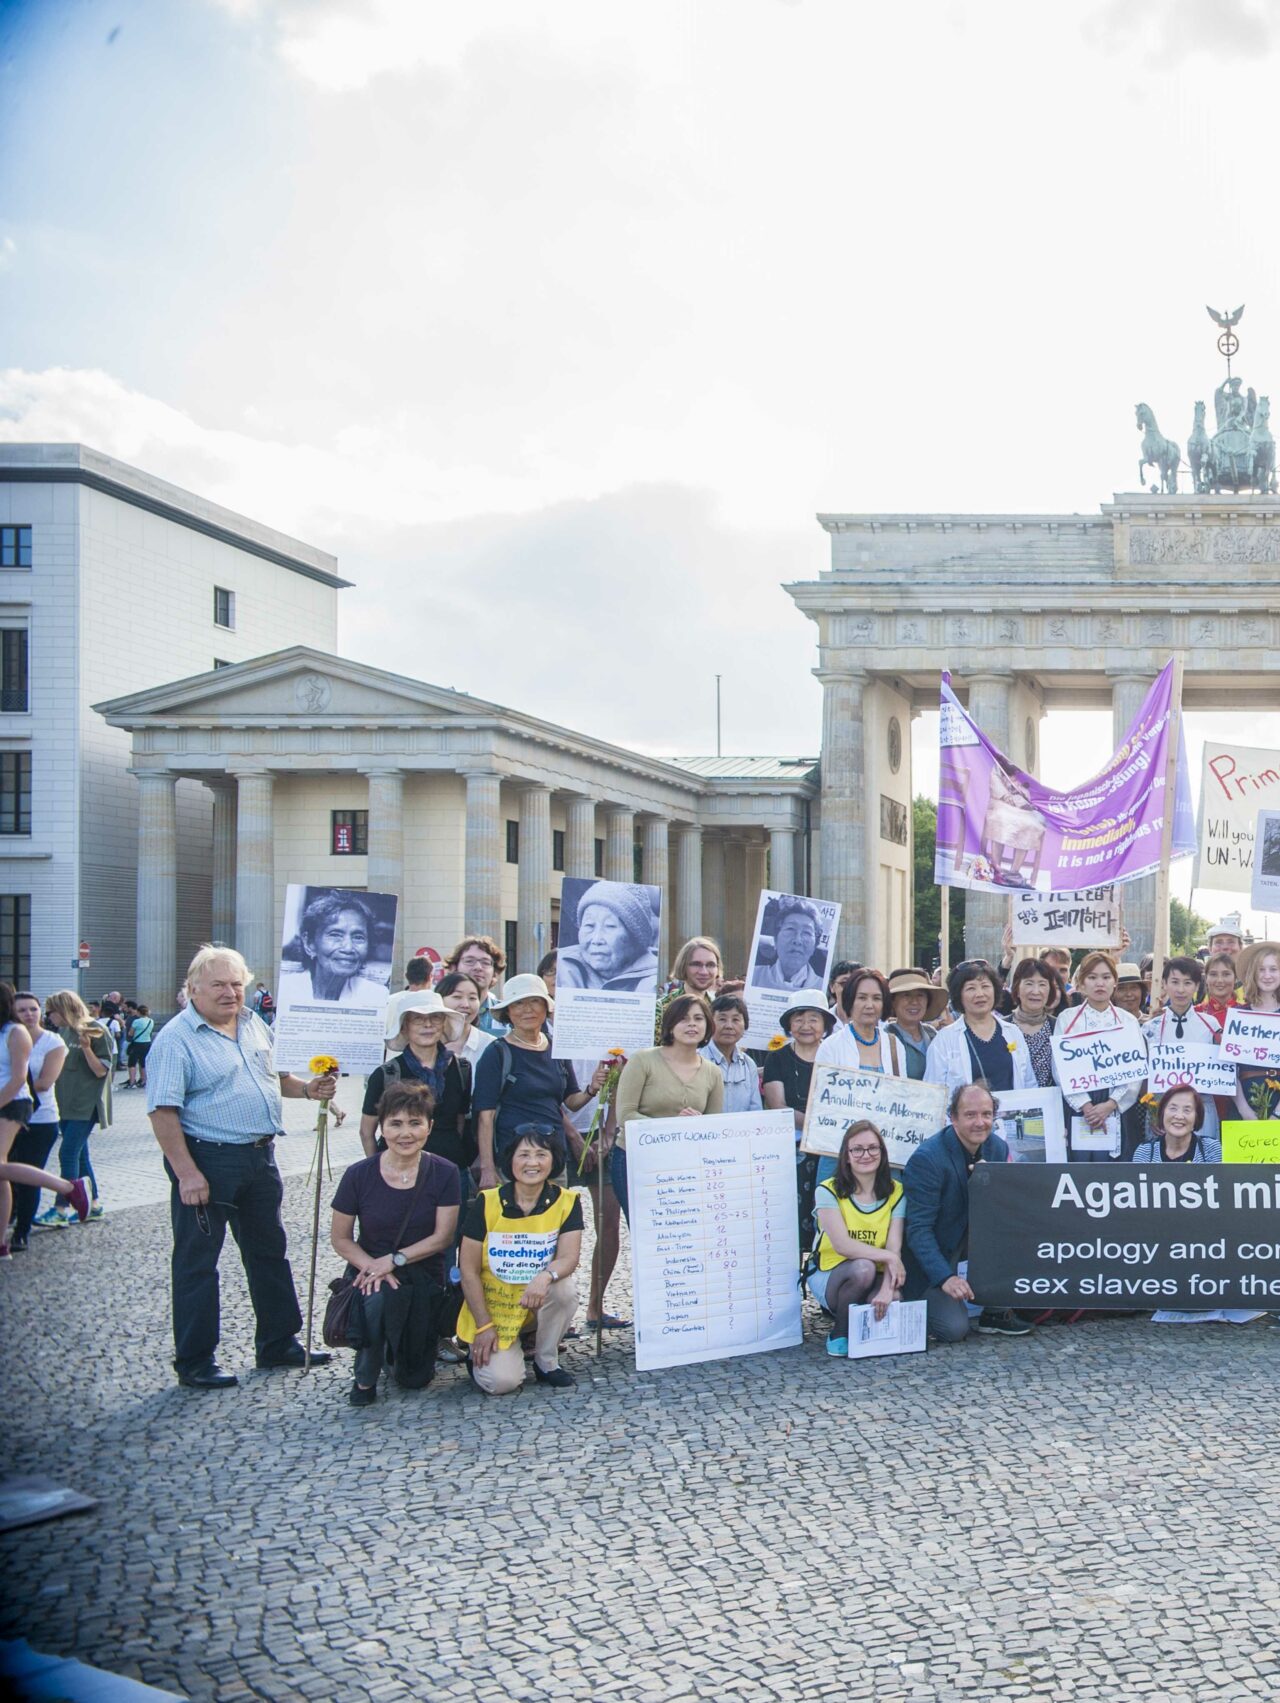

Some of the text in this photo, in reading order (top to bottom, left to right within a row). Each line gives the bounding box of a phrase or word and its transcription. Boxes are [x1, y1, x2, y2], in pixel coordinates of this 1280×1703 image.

[1208, 819, 1229, 840] Will
[1071, 855, 1082, 867] is
[1085, 850, 1105, 865] not
[1018, 907, 1117, 934] 당장 폐기하라
[1059, 1040, 1111, 1061] South
[1153, 1044, 1185, 1054] The
[1092, 1049, 1145, 1072] Korea
[1152, 1056, 1236, 1075] Philippines
[1070, 1067, 1148, 1090] 237 registered
[1154, 1071, 1193, 1087] 400
[820, 1088, 872, 1111] Annulliere
[875, 1102, 887, 1113] das
[639, 1134, 682, 1146] COMFORT
[880, 1126, 895, 1139] auf
[1051, 1174, 1220, 1217] Against
[1036, 1237, 1159, 1264] apology
[1169, 1238, 1225, 1259] and
[1013, 1277, 1069, 1294] sex
[1078, 1273, 1177, 1295] slaves
[1187, 1273, 1230, 1295] for
